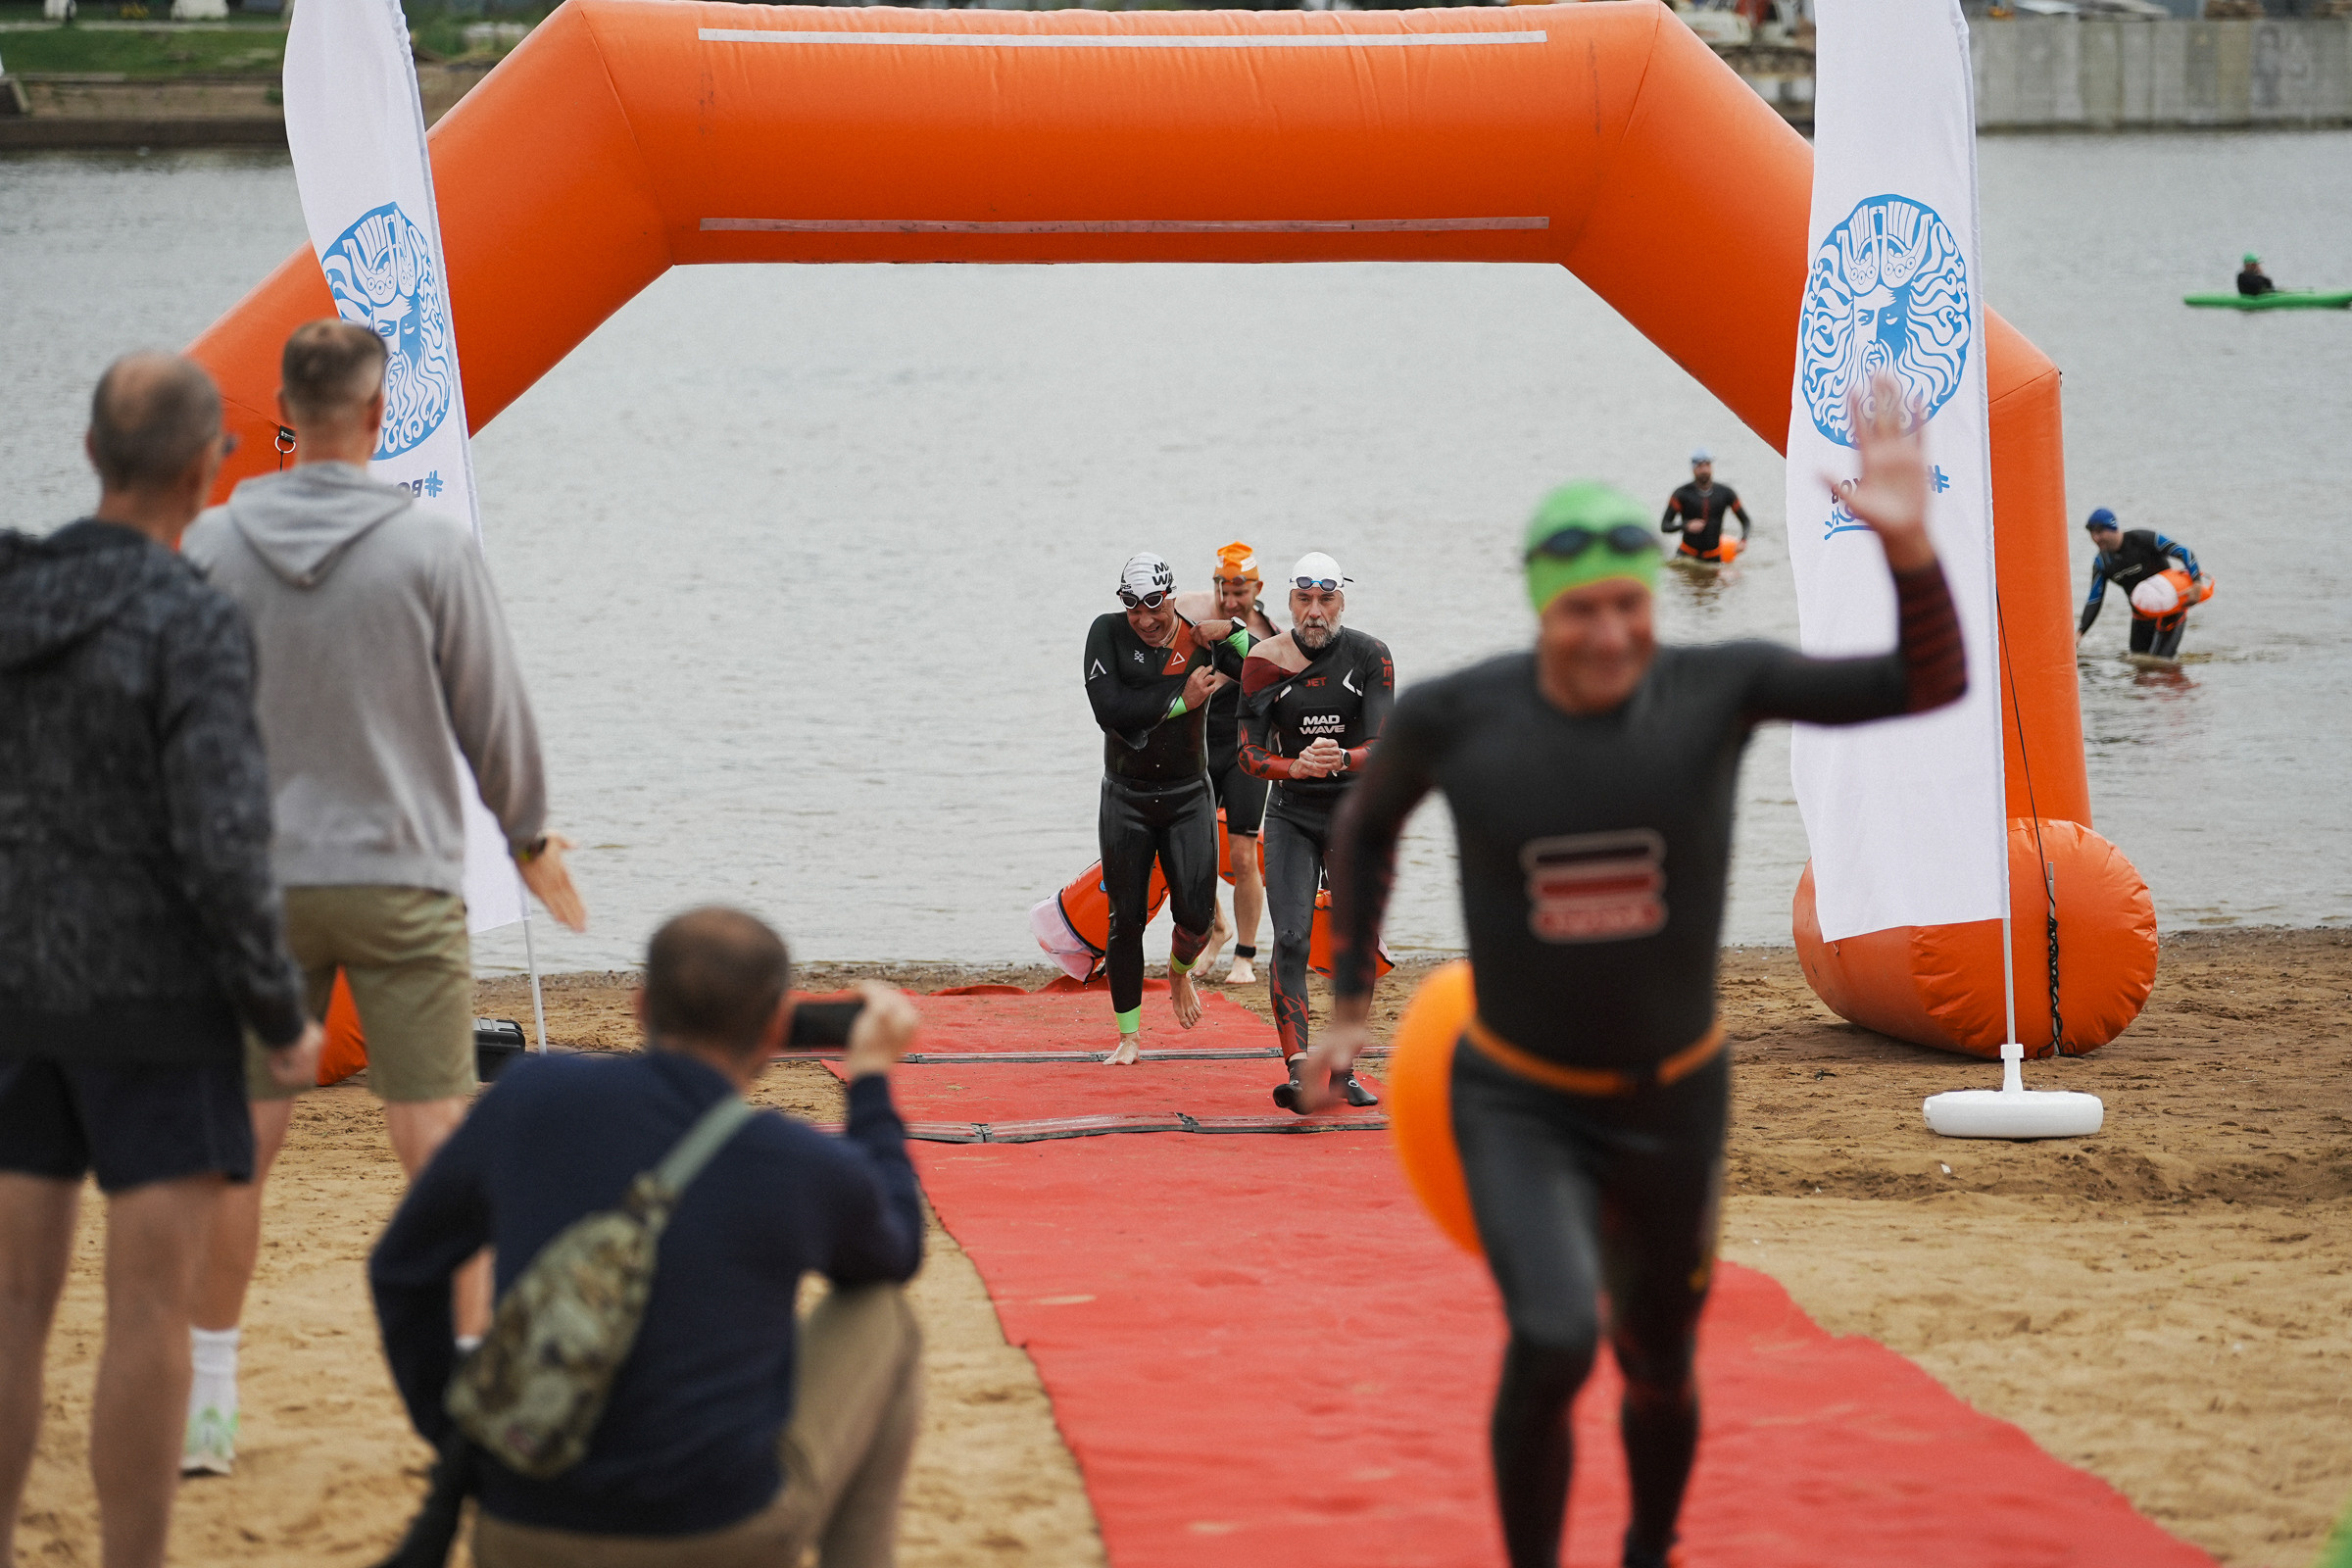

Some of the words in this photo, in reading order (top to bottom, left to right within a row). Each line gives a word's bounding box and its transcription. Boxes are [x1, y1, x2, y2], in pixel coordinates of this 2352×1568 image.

[1380, 657, 1393, 691] JET
[1305, 676, 1327, 687] JET
[1303, 715, 1341, 725] MAD
[1298, 724, 1346, 735] WAVE
